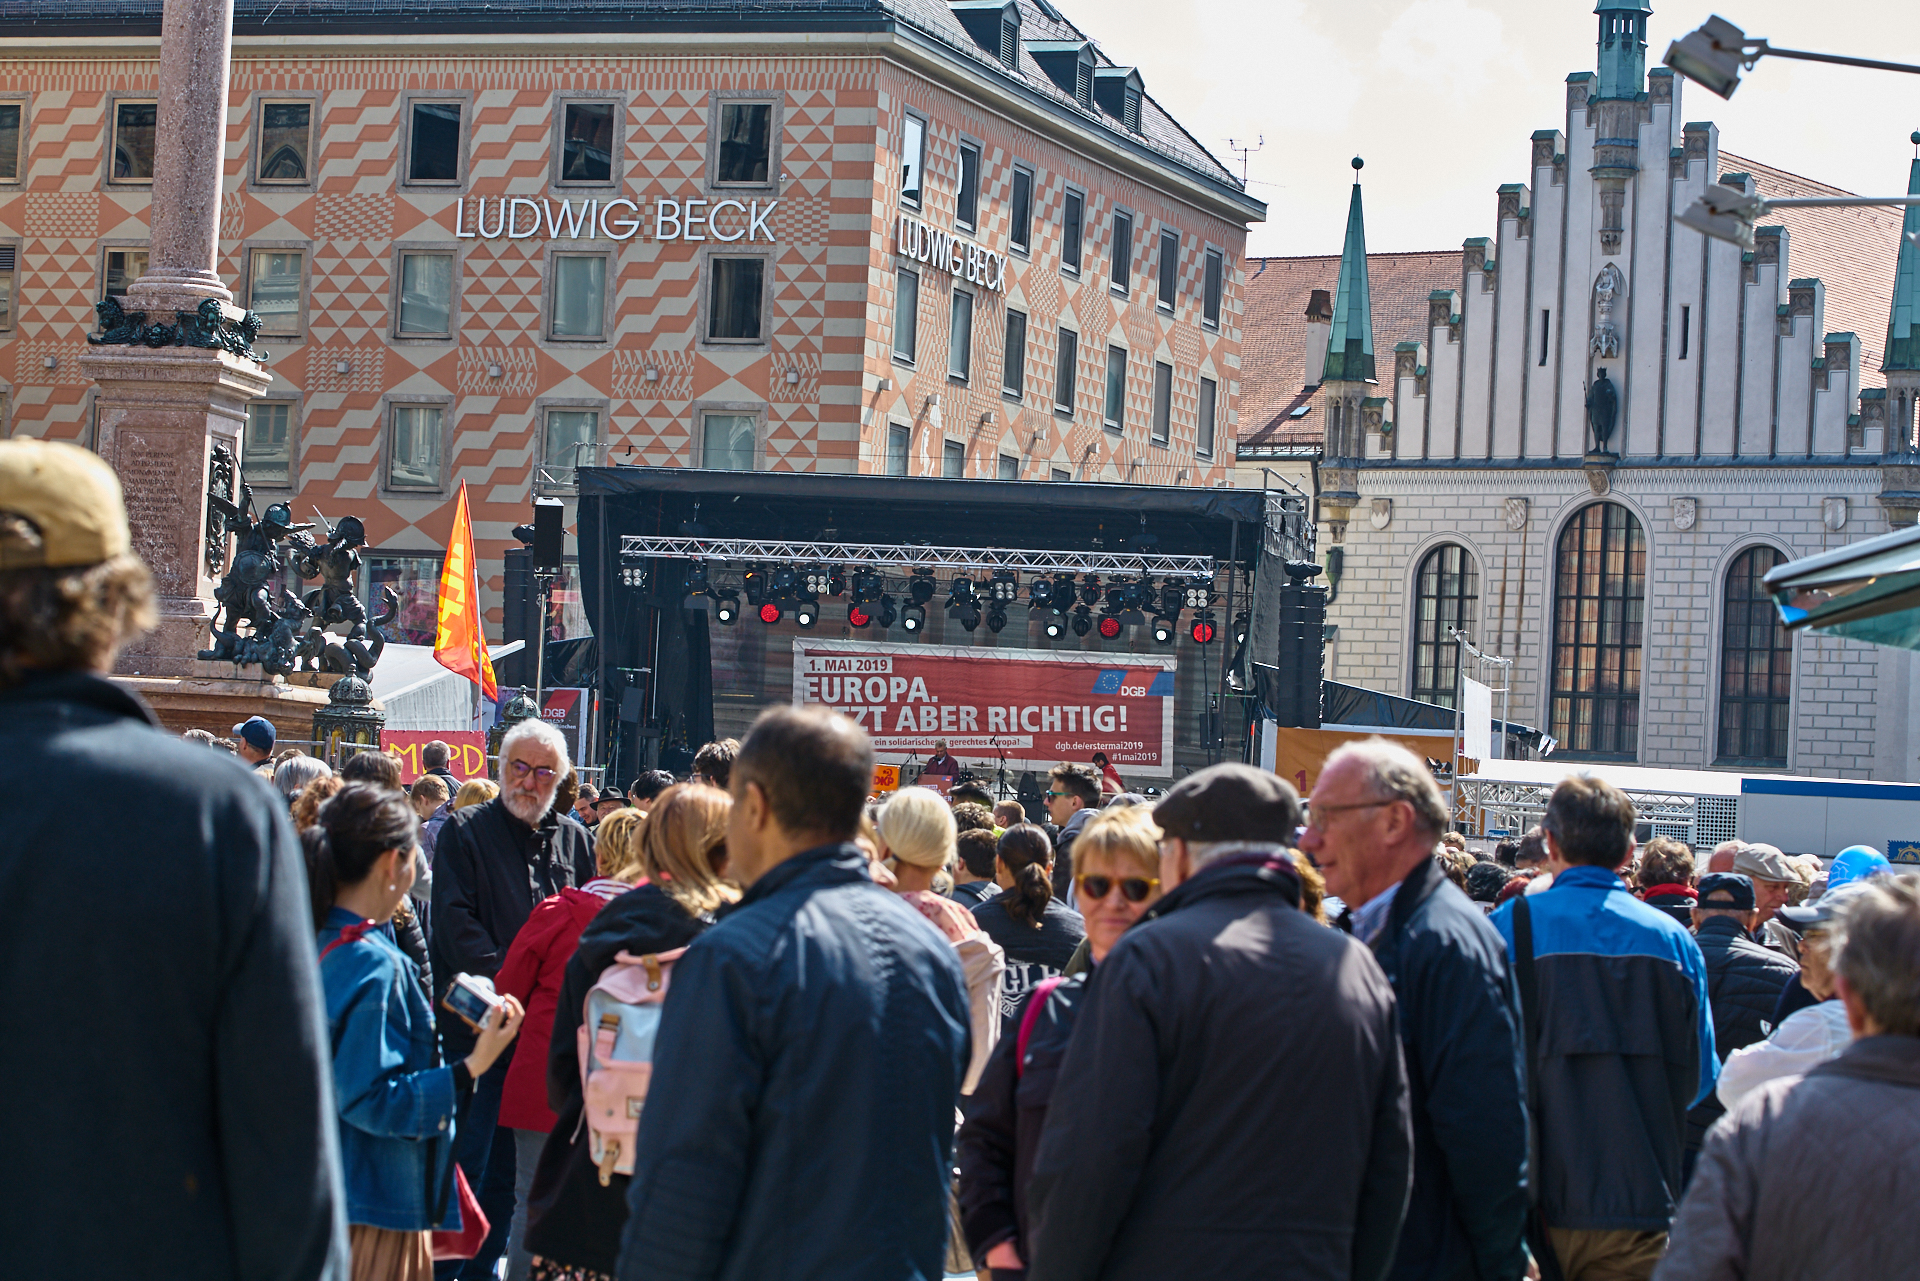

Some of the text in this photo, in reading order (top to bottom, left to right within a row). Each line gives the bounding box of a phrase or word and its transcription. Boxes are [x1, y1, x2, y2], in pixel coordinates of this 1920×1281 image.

[455, 197, 778, 242] LUDWIG BECK
[898, 213, 1008, 295] LUDWIG BECK
[809, 659, 888, 672] 1. MAI 2019
[803, 677, 938, 703] EUROPA.
[1121, 686, 1146, 697] DGB
[543, 708, 566, 718] DGB
[895, 705, 979, 732] ABER
[987, 705, 1128, 733] RICHTIG!
[874, 737, 887, 746] ein
[949, 738, 988, 748] gerechtes
[1055, 741, 1144, 752] dgb.de/erstermai2019
[1112, 752, 1158, 761] #1mai2019
